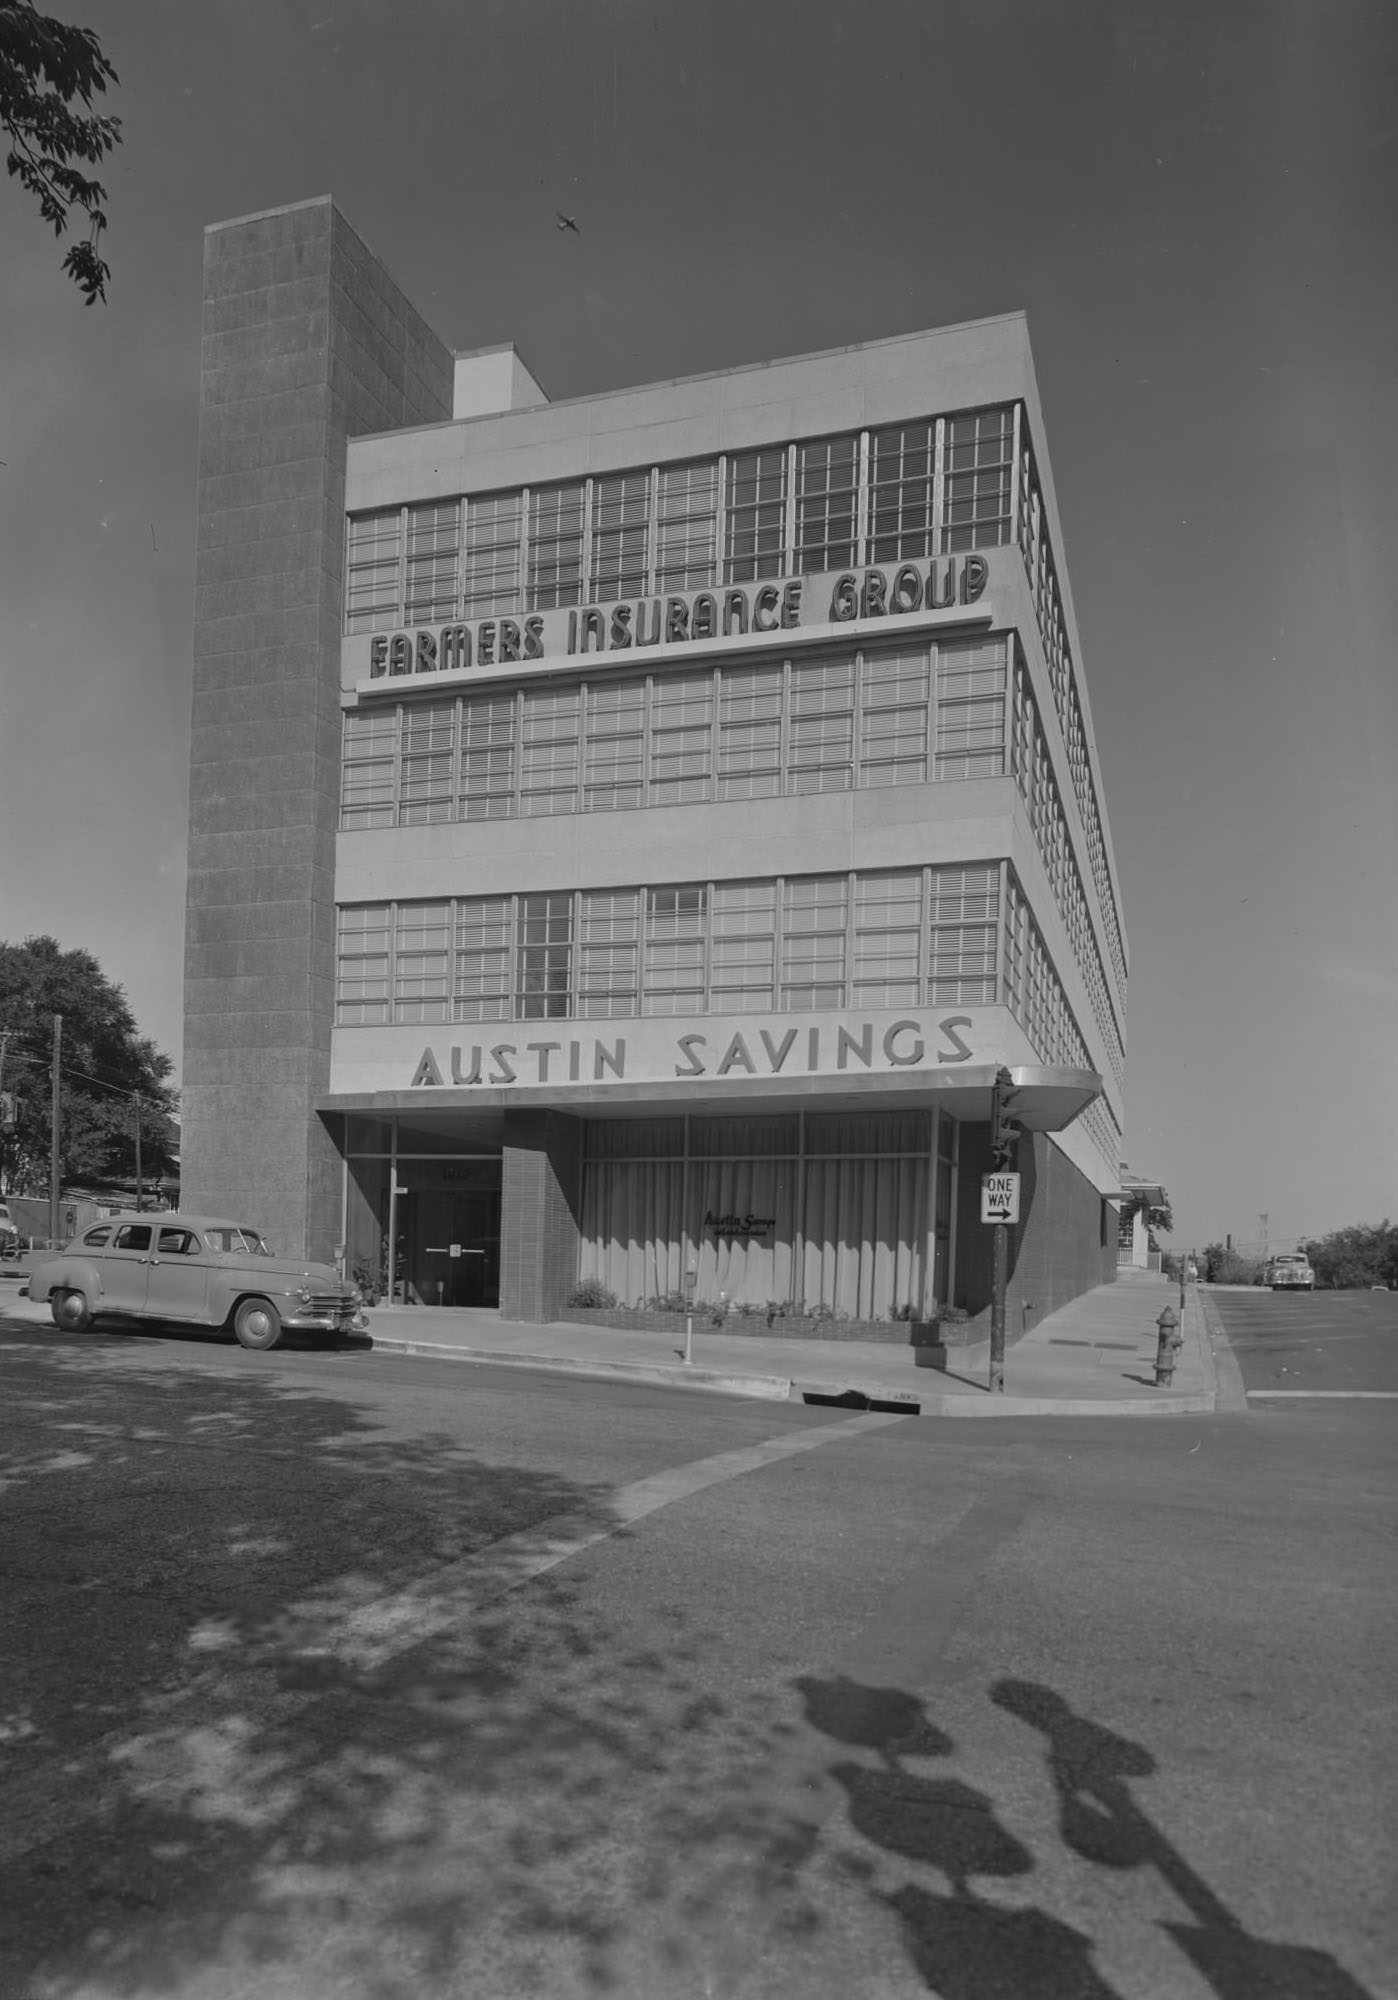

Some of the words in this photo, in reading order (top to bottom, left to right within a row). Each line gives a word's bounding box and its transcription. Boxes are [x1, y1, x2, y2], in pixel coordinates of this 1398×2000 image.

[371, 616, 544, 679] FARMERS
[568, 581, 802, 655] INSURANCE
[830, 555, 989, 622] GROUP
[411, 1038, 626, 1086] AUSTIN
[675, 1016, 973, 1076] SAVINGS
[988, 1178, 1013, 1192] ONE
[988, 1193, 1012, 1207] WAY
